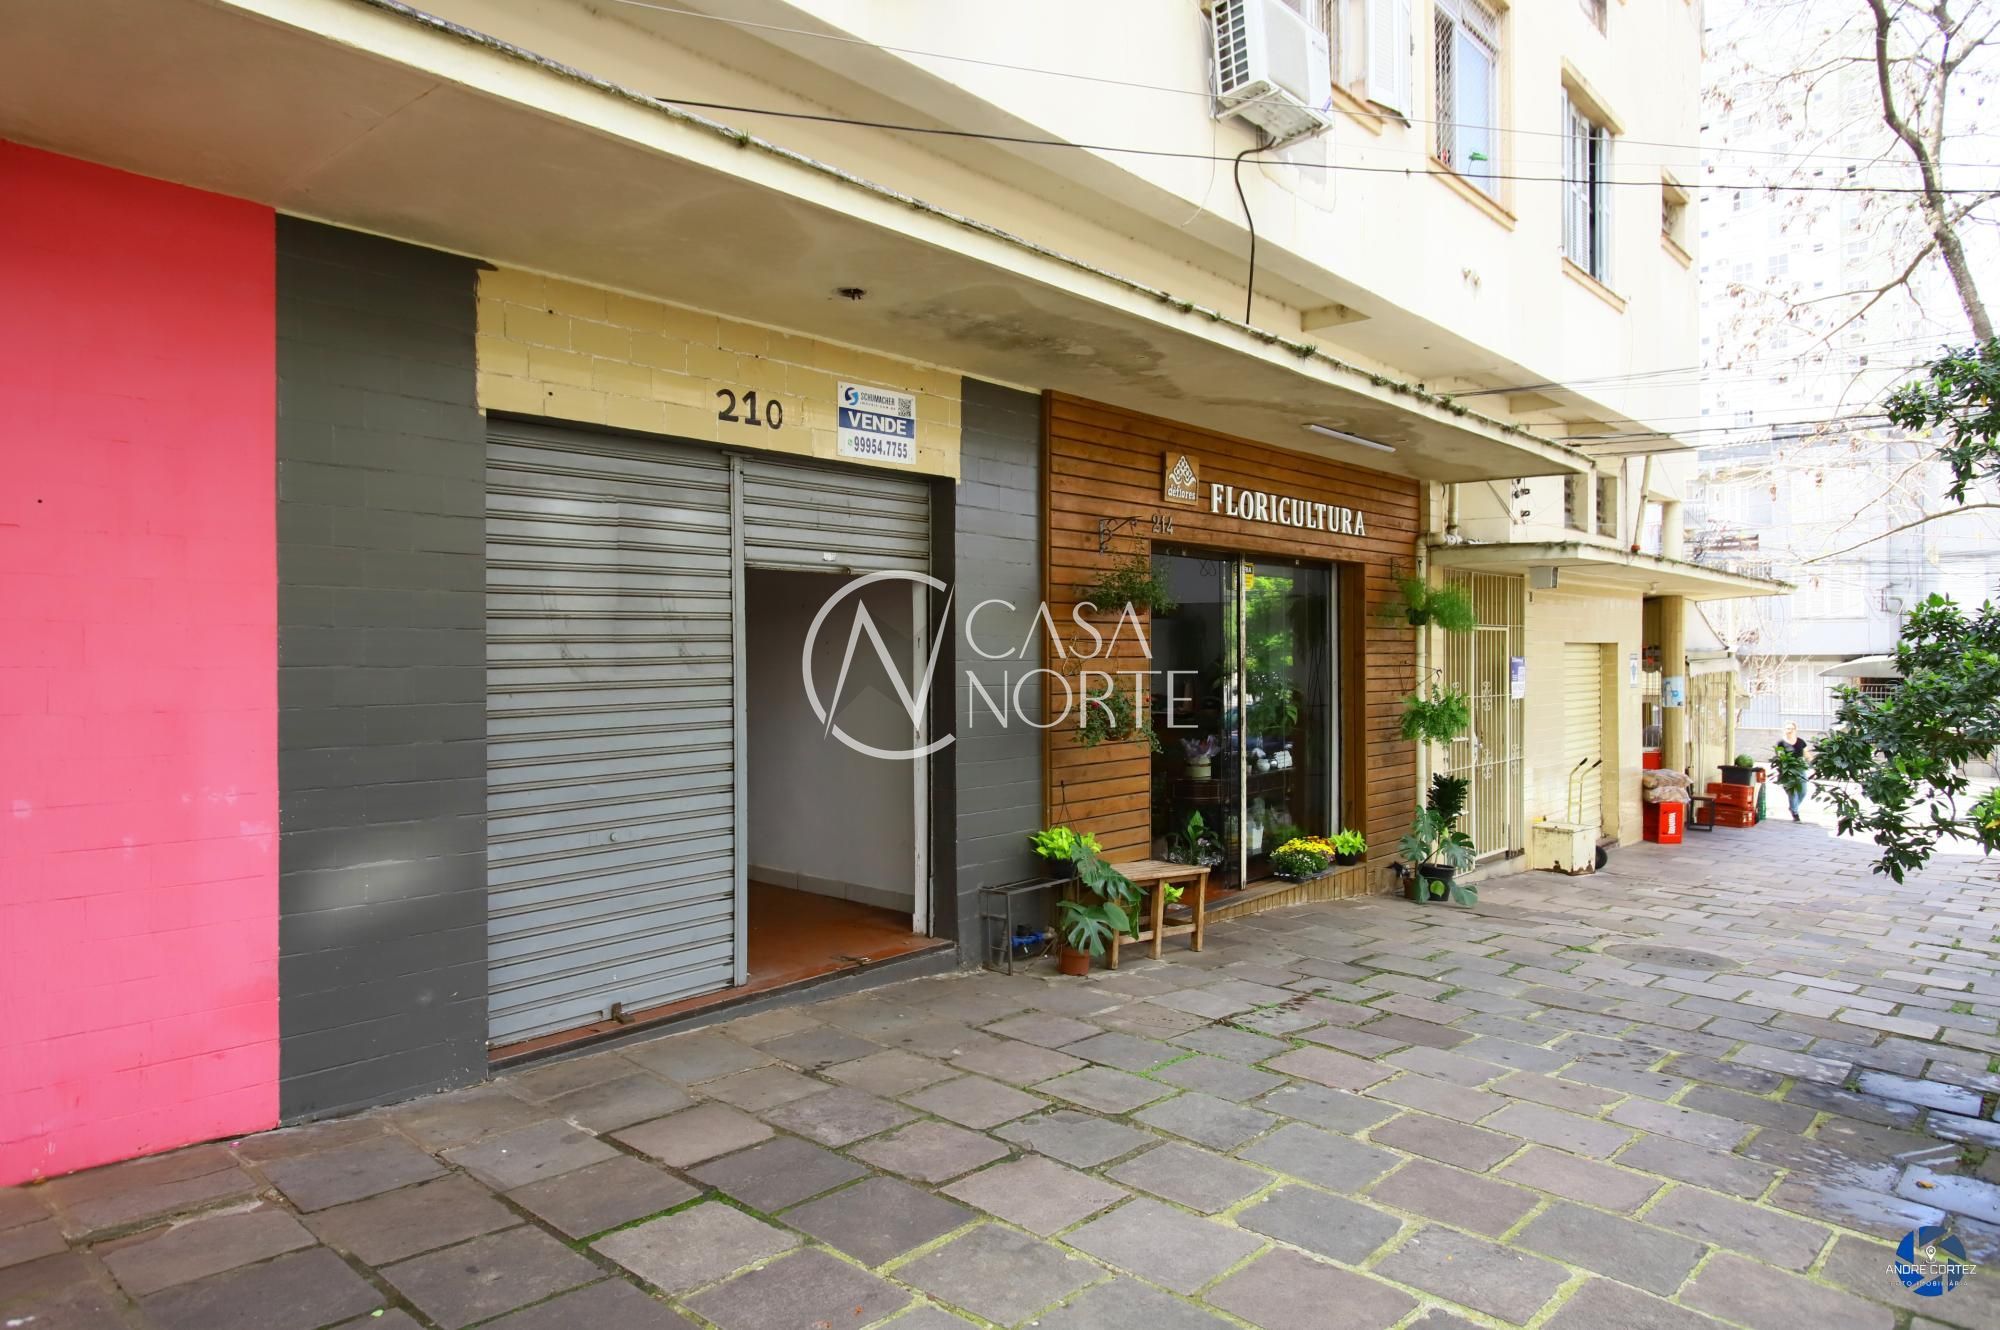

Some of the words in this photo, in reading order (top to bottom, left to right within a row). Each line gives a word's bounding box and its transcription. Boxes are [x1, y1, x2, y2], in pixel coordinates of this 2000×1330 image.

[715, 388, 783, 430] 210
[861, 392, 895, 406] SCHUMACHER
[848, 411, 907, 436] VENDE
[854, 435, 908, 459] 99954.7755
[1210, 483, 1366, 536] FLORICULTURA
[1152, 514, 1174, 535] 214
